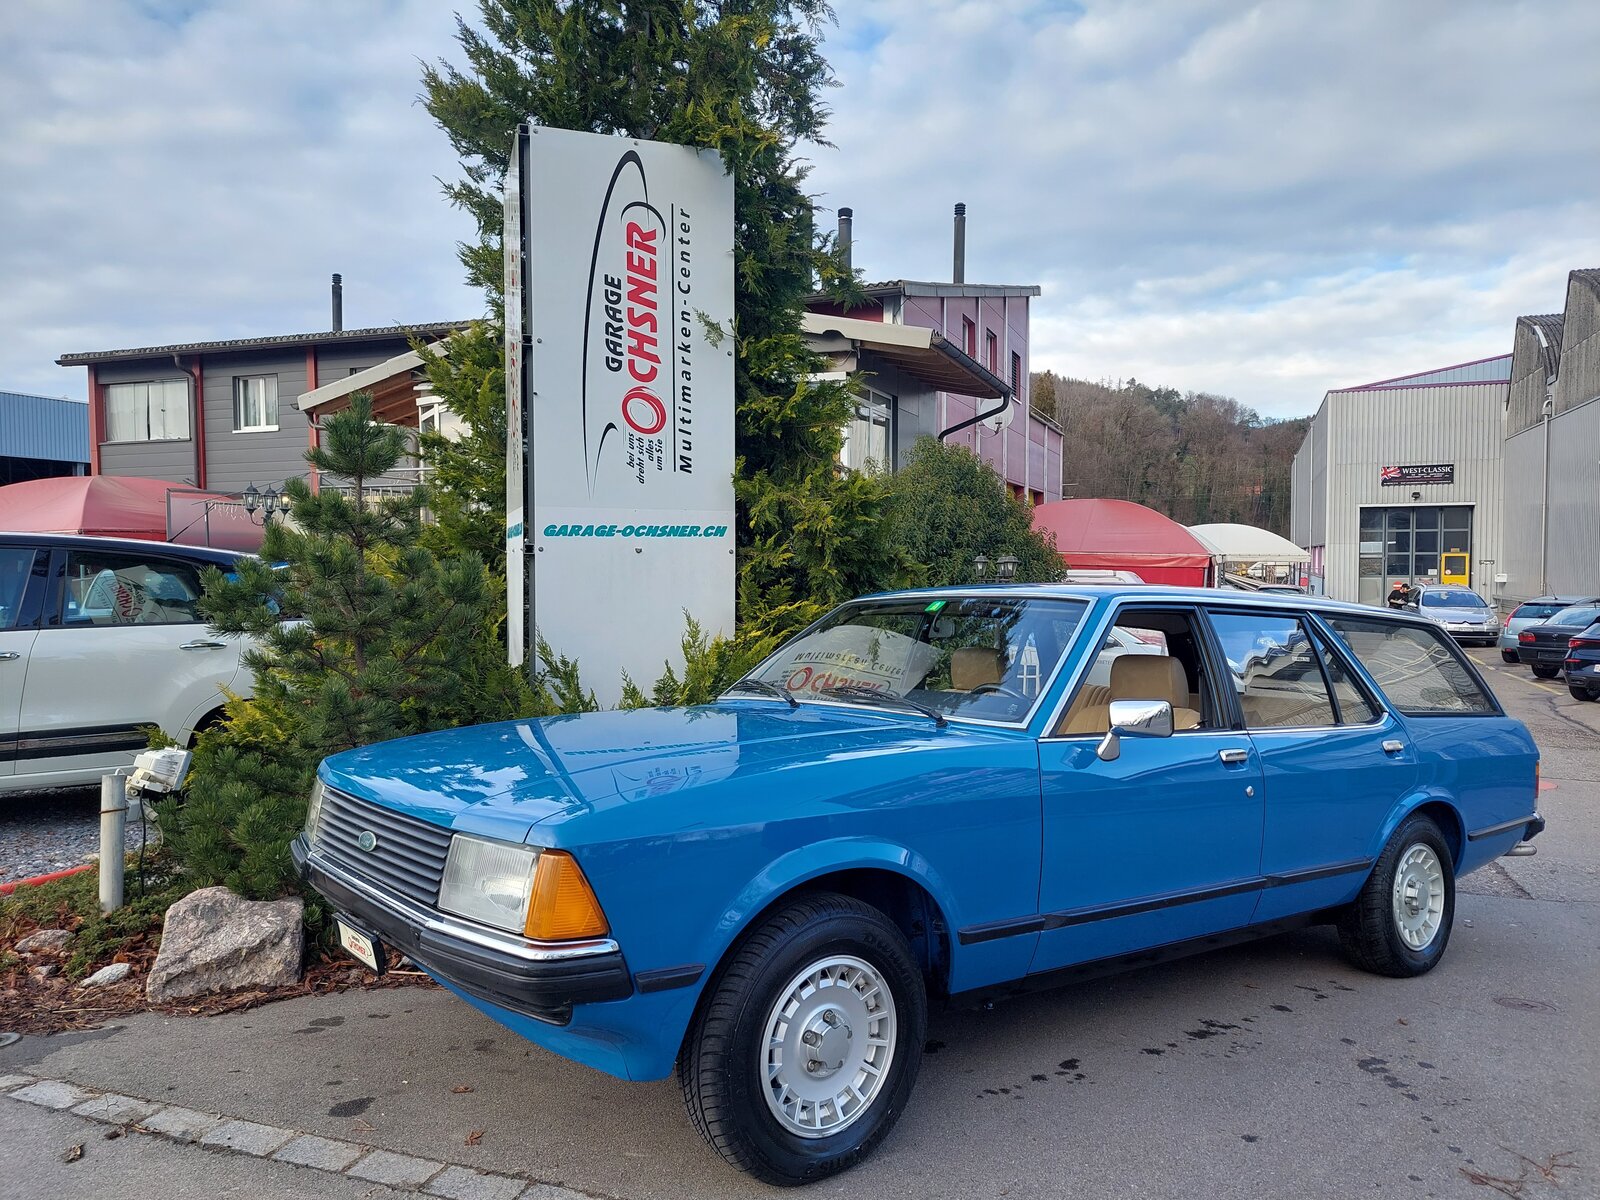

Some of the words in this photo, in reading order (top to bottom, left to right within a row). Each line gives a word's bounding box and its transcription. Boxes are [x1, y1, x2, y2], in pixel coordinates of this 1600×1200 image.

[604, 274, 624, 372] GARAGE
[622, 222, 667, 434] OCHSNER
[678, 208, 692, 474] Multimarken-Center
[636, 437, 645, 456] sich
[645, 439, 654, 461] alles
[655, 439, 663, 454] Sie
[627, 451, 635, 468] bei
[656, 455, 663, 471] um
[636, 457, 645, 484] dreht
[1402, 466, 1453, 474] WEST-CLASSIC
[543, 524, 728, 538] GARAGE-OCHSNER.CH
